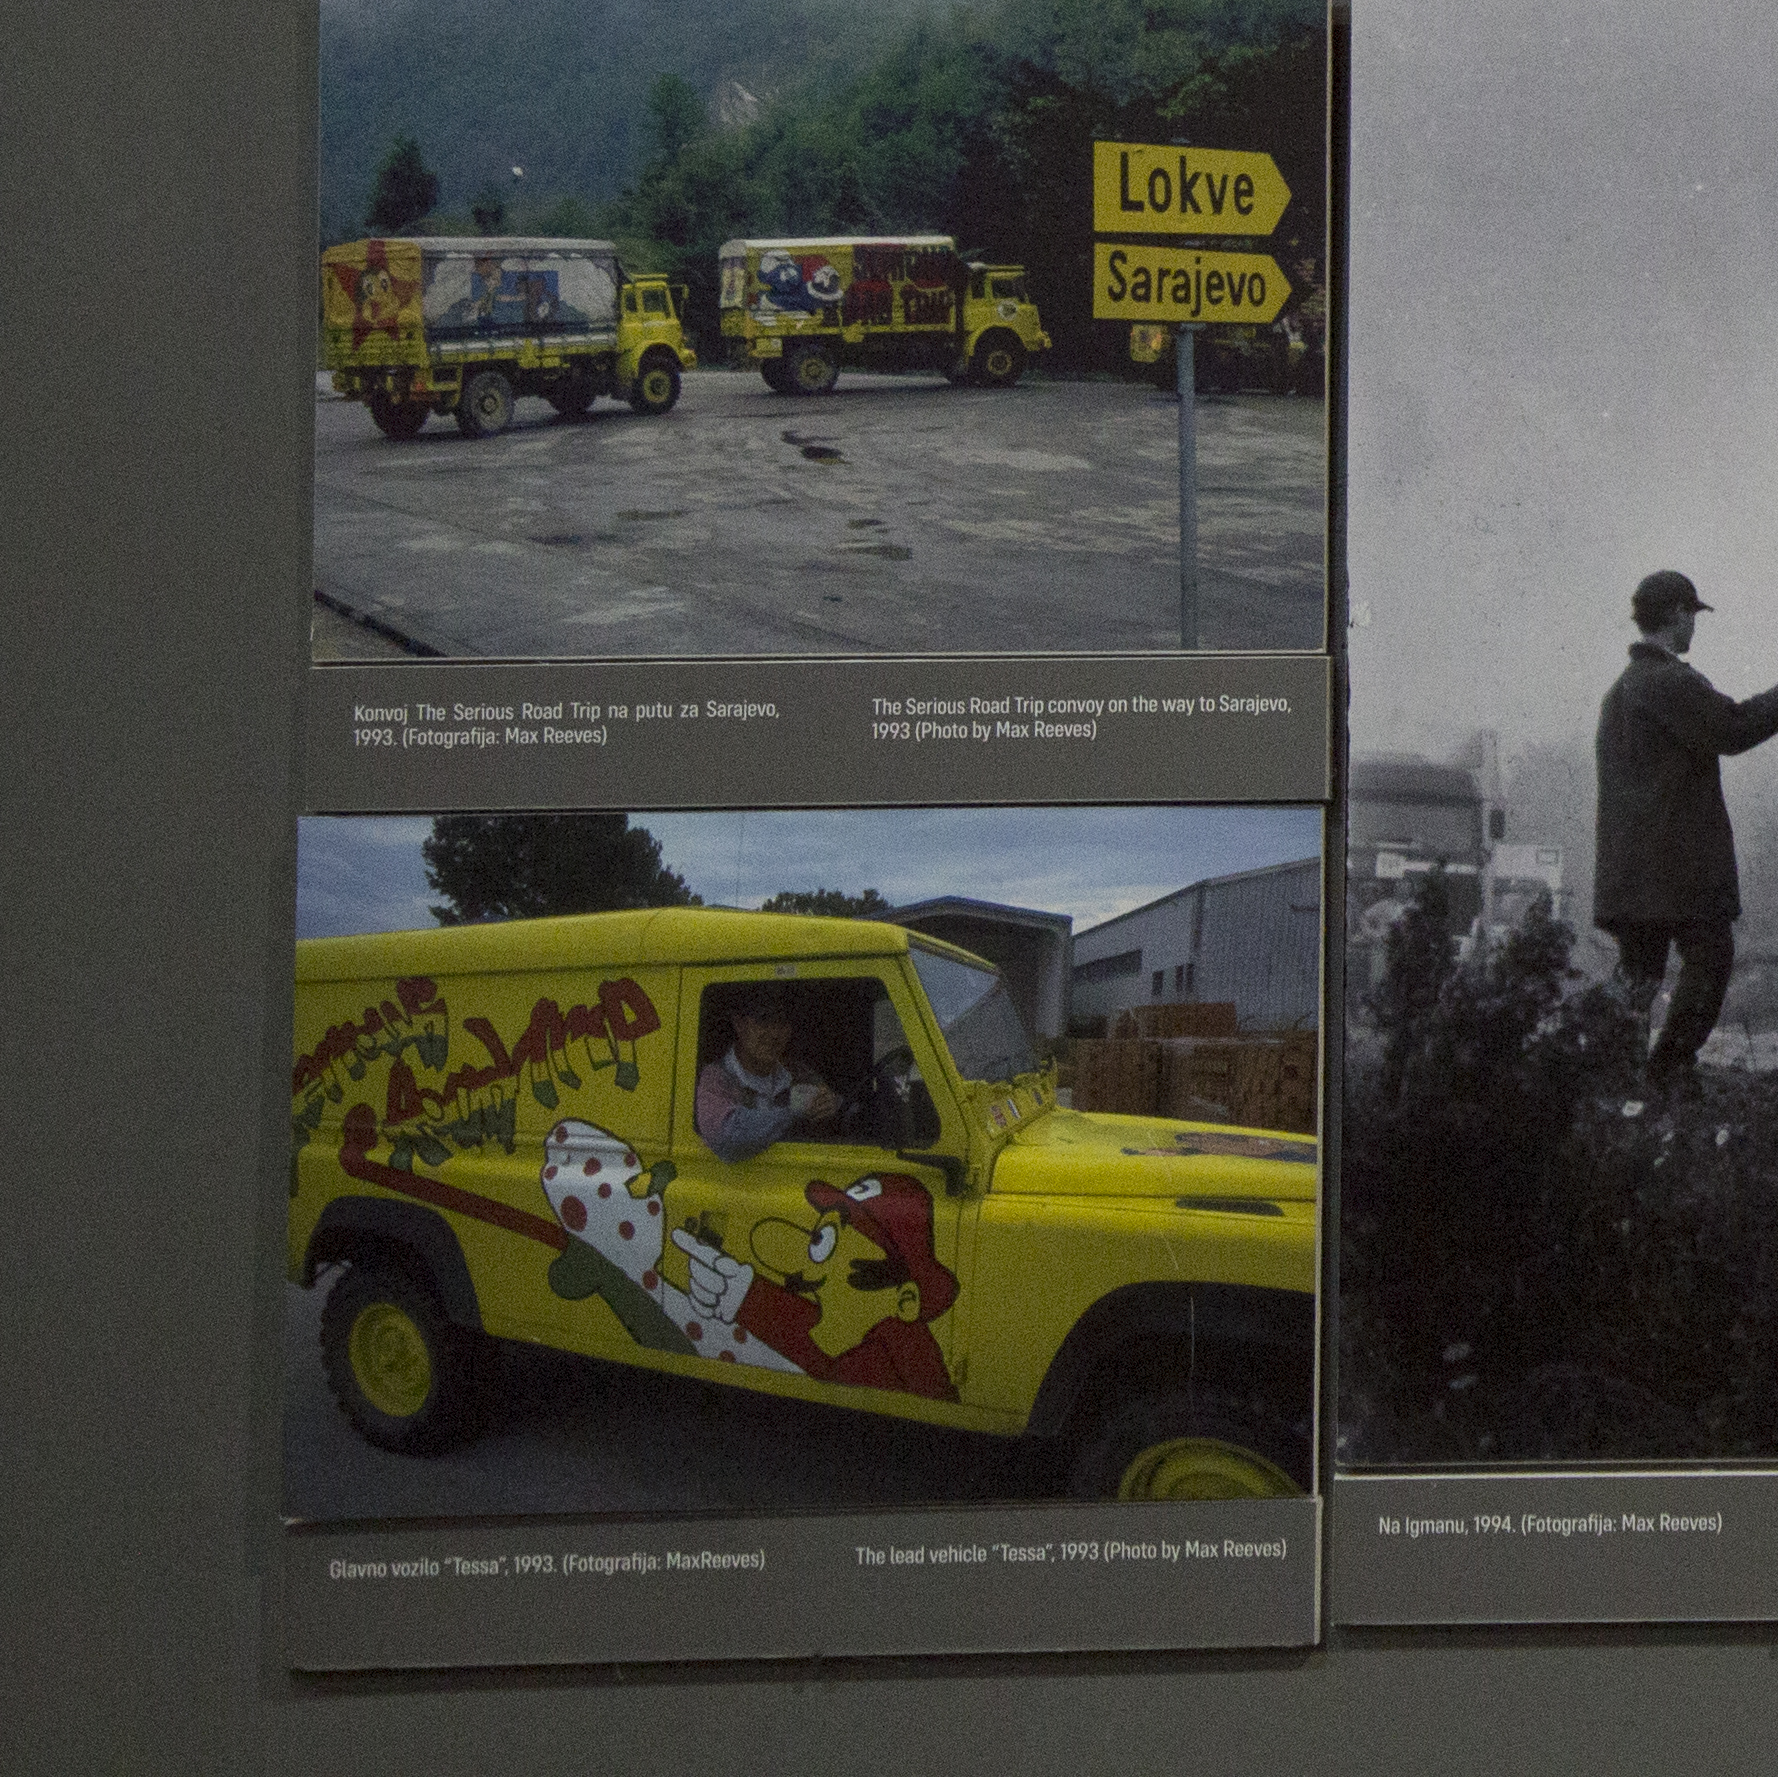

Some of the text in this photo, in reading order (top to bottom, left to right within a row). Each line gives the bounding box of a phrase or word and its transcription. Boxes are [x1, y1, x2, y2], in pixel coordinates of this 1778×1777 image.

[1119, 150, 1255, 216] Lokve
[1107, 249, 1267, 318] Sarajevo
[1377, 1511, 1724, 1539] Na Igmanu, 1994. (Fotografija: Max Reeves)
[328, 1559, 388, 1579] Glavno
[390, 1557, 441, 1578] vozilo
[513, 1553, 557, 1574] 1993.
[561, 1551, 662, 1577] (Fotografija:
[665, 1547, 767, 1572] MaxReeves)
